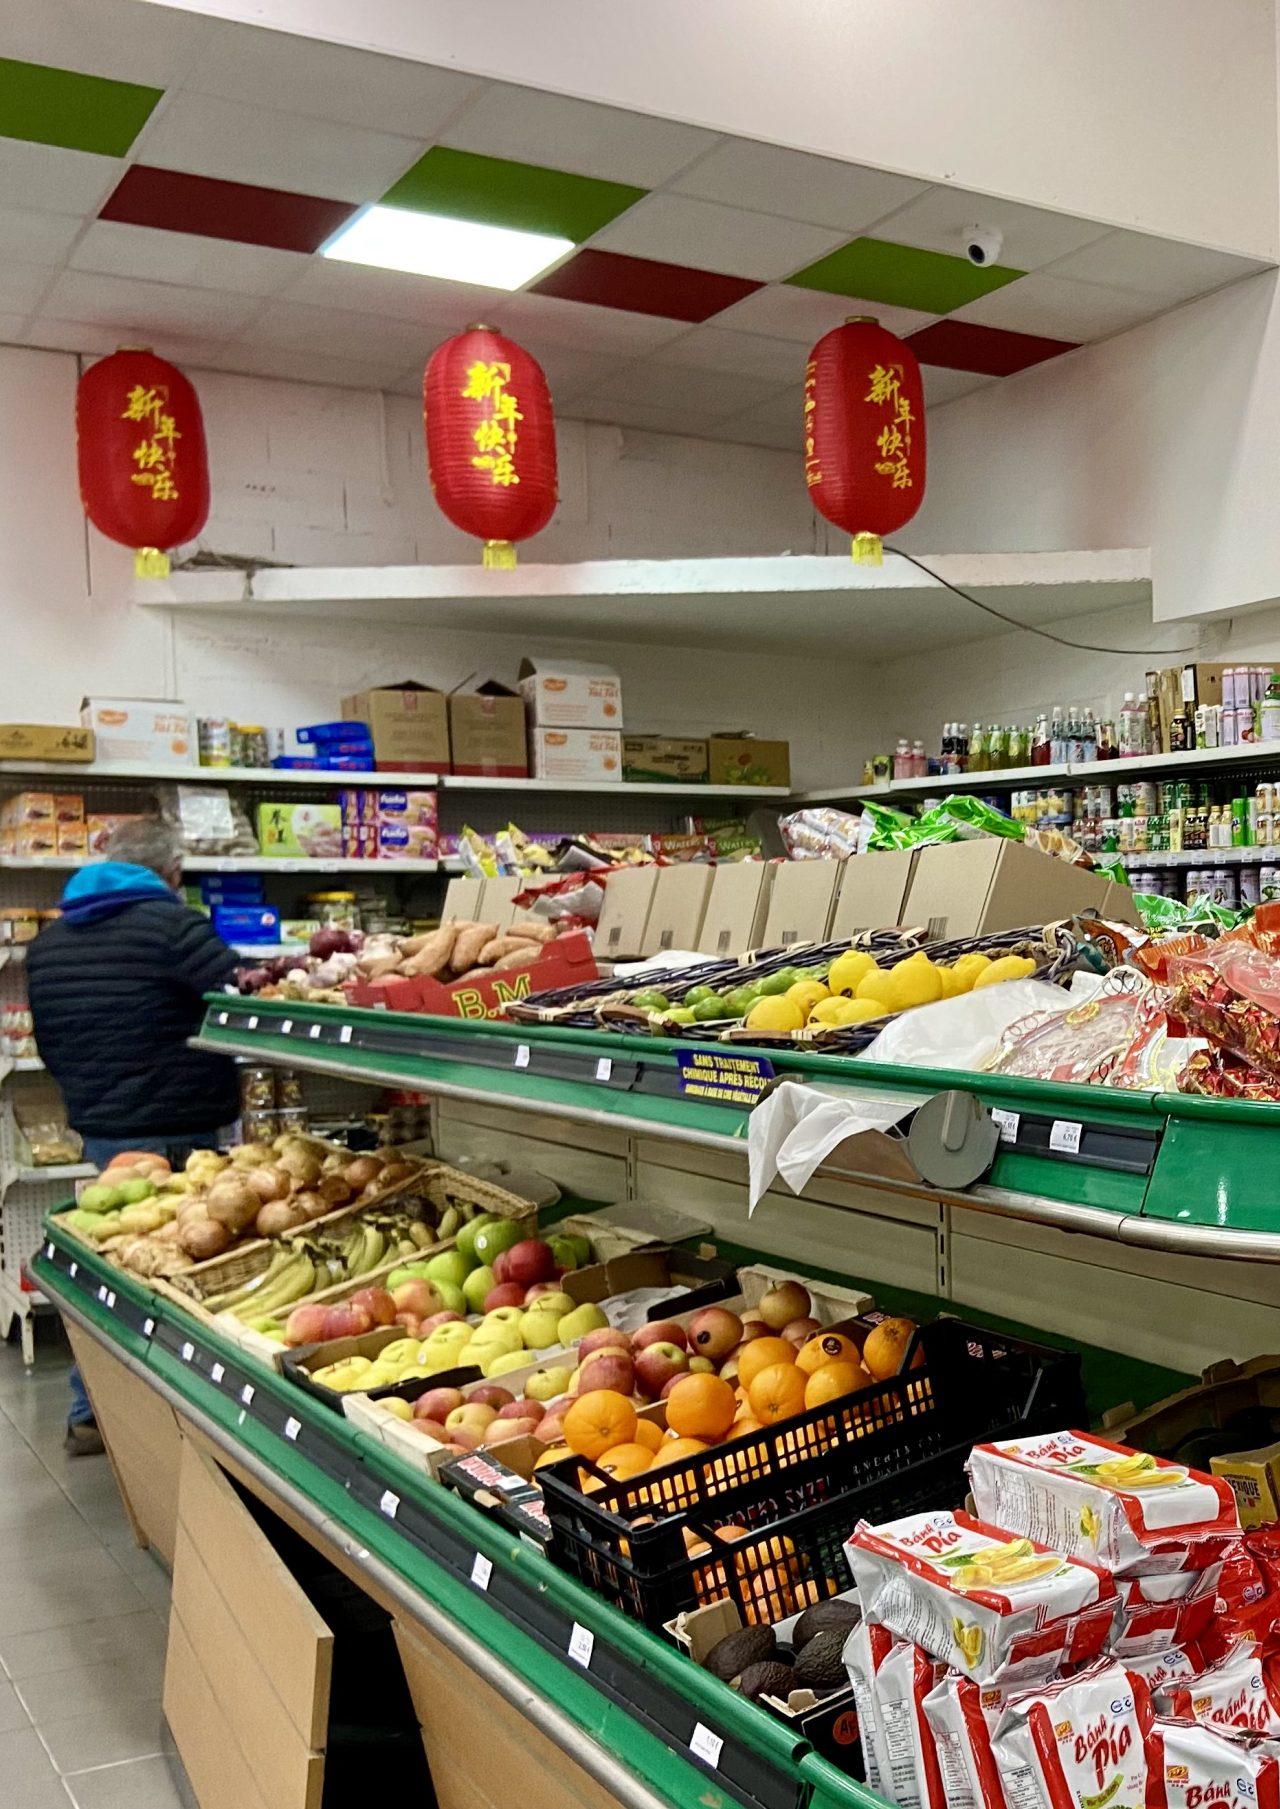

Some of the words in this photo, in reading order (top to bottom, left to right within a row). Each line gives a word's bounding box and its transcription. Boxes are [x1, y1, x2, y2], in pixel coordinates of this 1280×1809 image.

[693, 1053, 714, 1068] SANS
[713, 1056, 760, 1074] TRAITEMENT
[1025, 1439, 1058, 1460] Bánh
[1048, 1443, 1086, 1463] Pía
[899, 1522, 934, 1549] Bánh
[921, 1530, 962, 1554] Pía
[1211, 1687, 1246, 1724] Bánh
[1074, 1714, 1107, 1764] Bánh
[1091, 1723, 1132, 1790] Pía
[1185, 1779, 1231, 1809] Bánh
